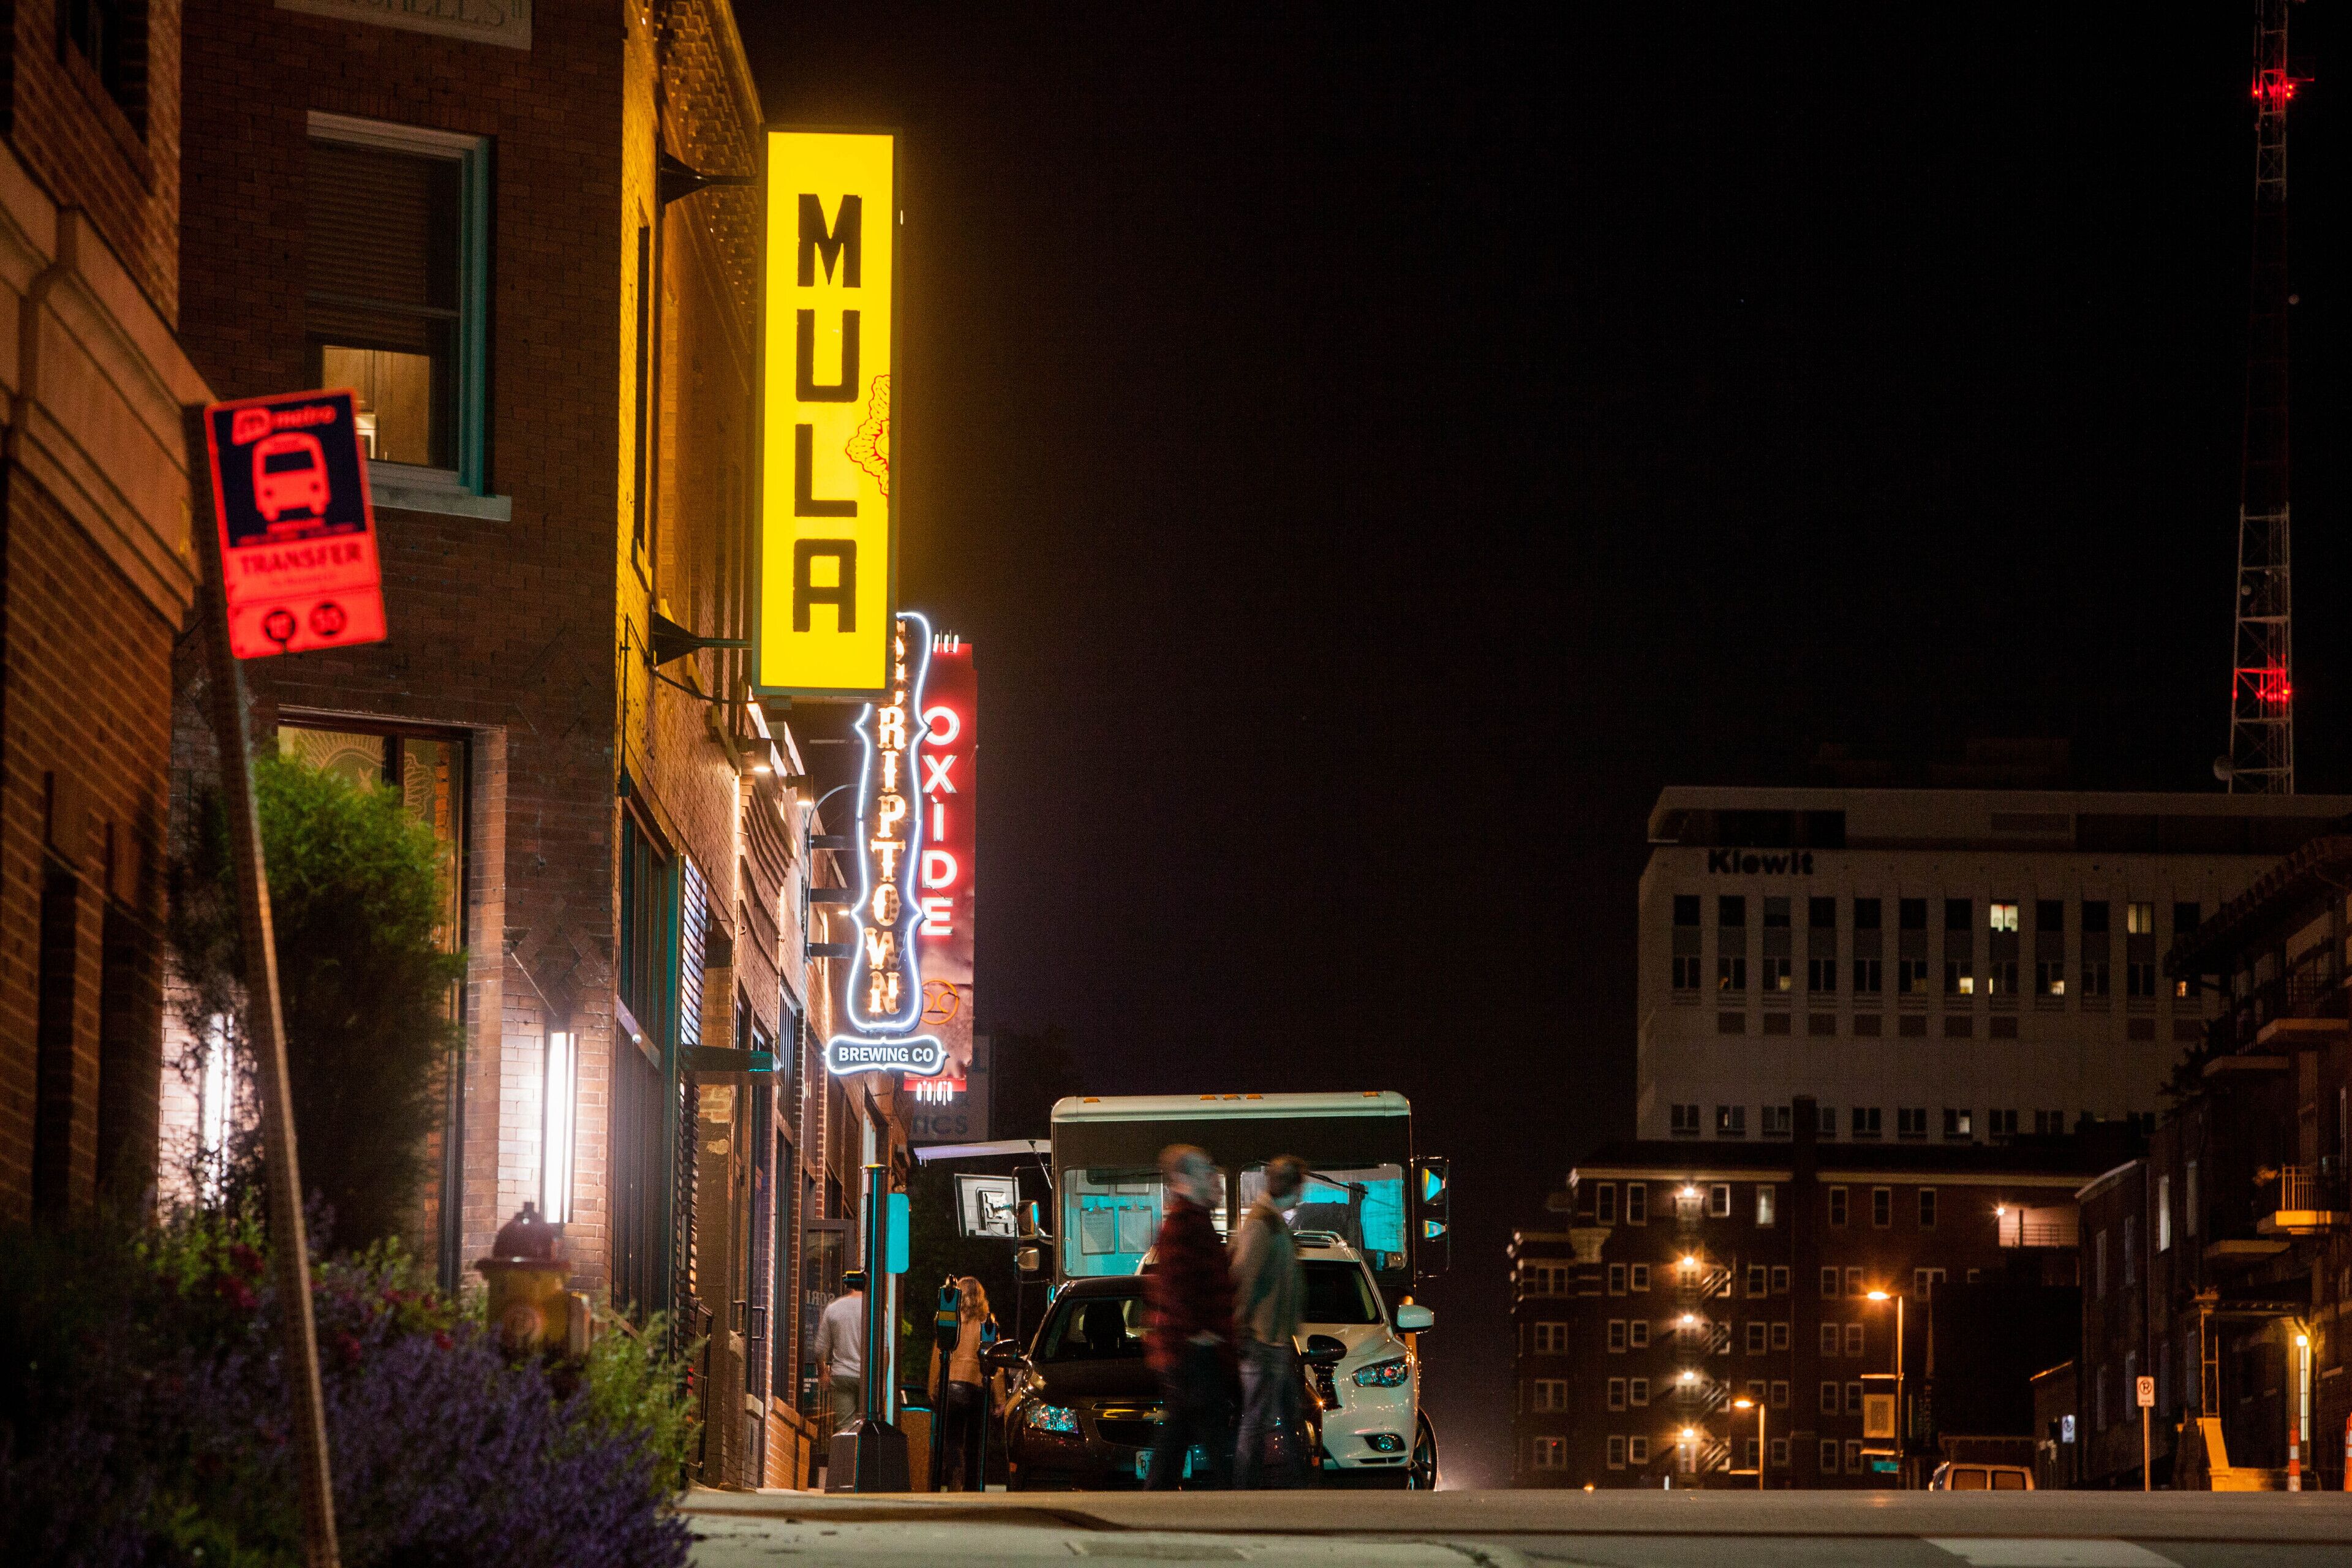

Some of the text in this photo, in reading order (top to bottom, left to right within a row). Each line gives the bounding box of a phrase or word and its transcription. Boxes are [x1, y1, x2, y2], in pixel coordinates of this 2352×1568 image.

[793, 193, 862, 633] MULA
[239, 542, 361, 575] TRANSFER
[920, 706, 961, 936] OXIDE
[839, 1047, 934, 1062] BREWING CO
